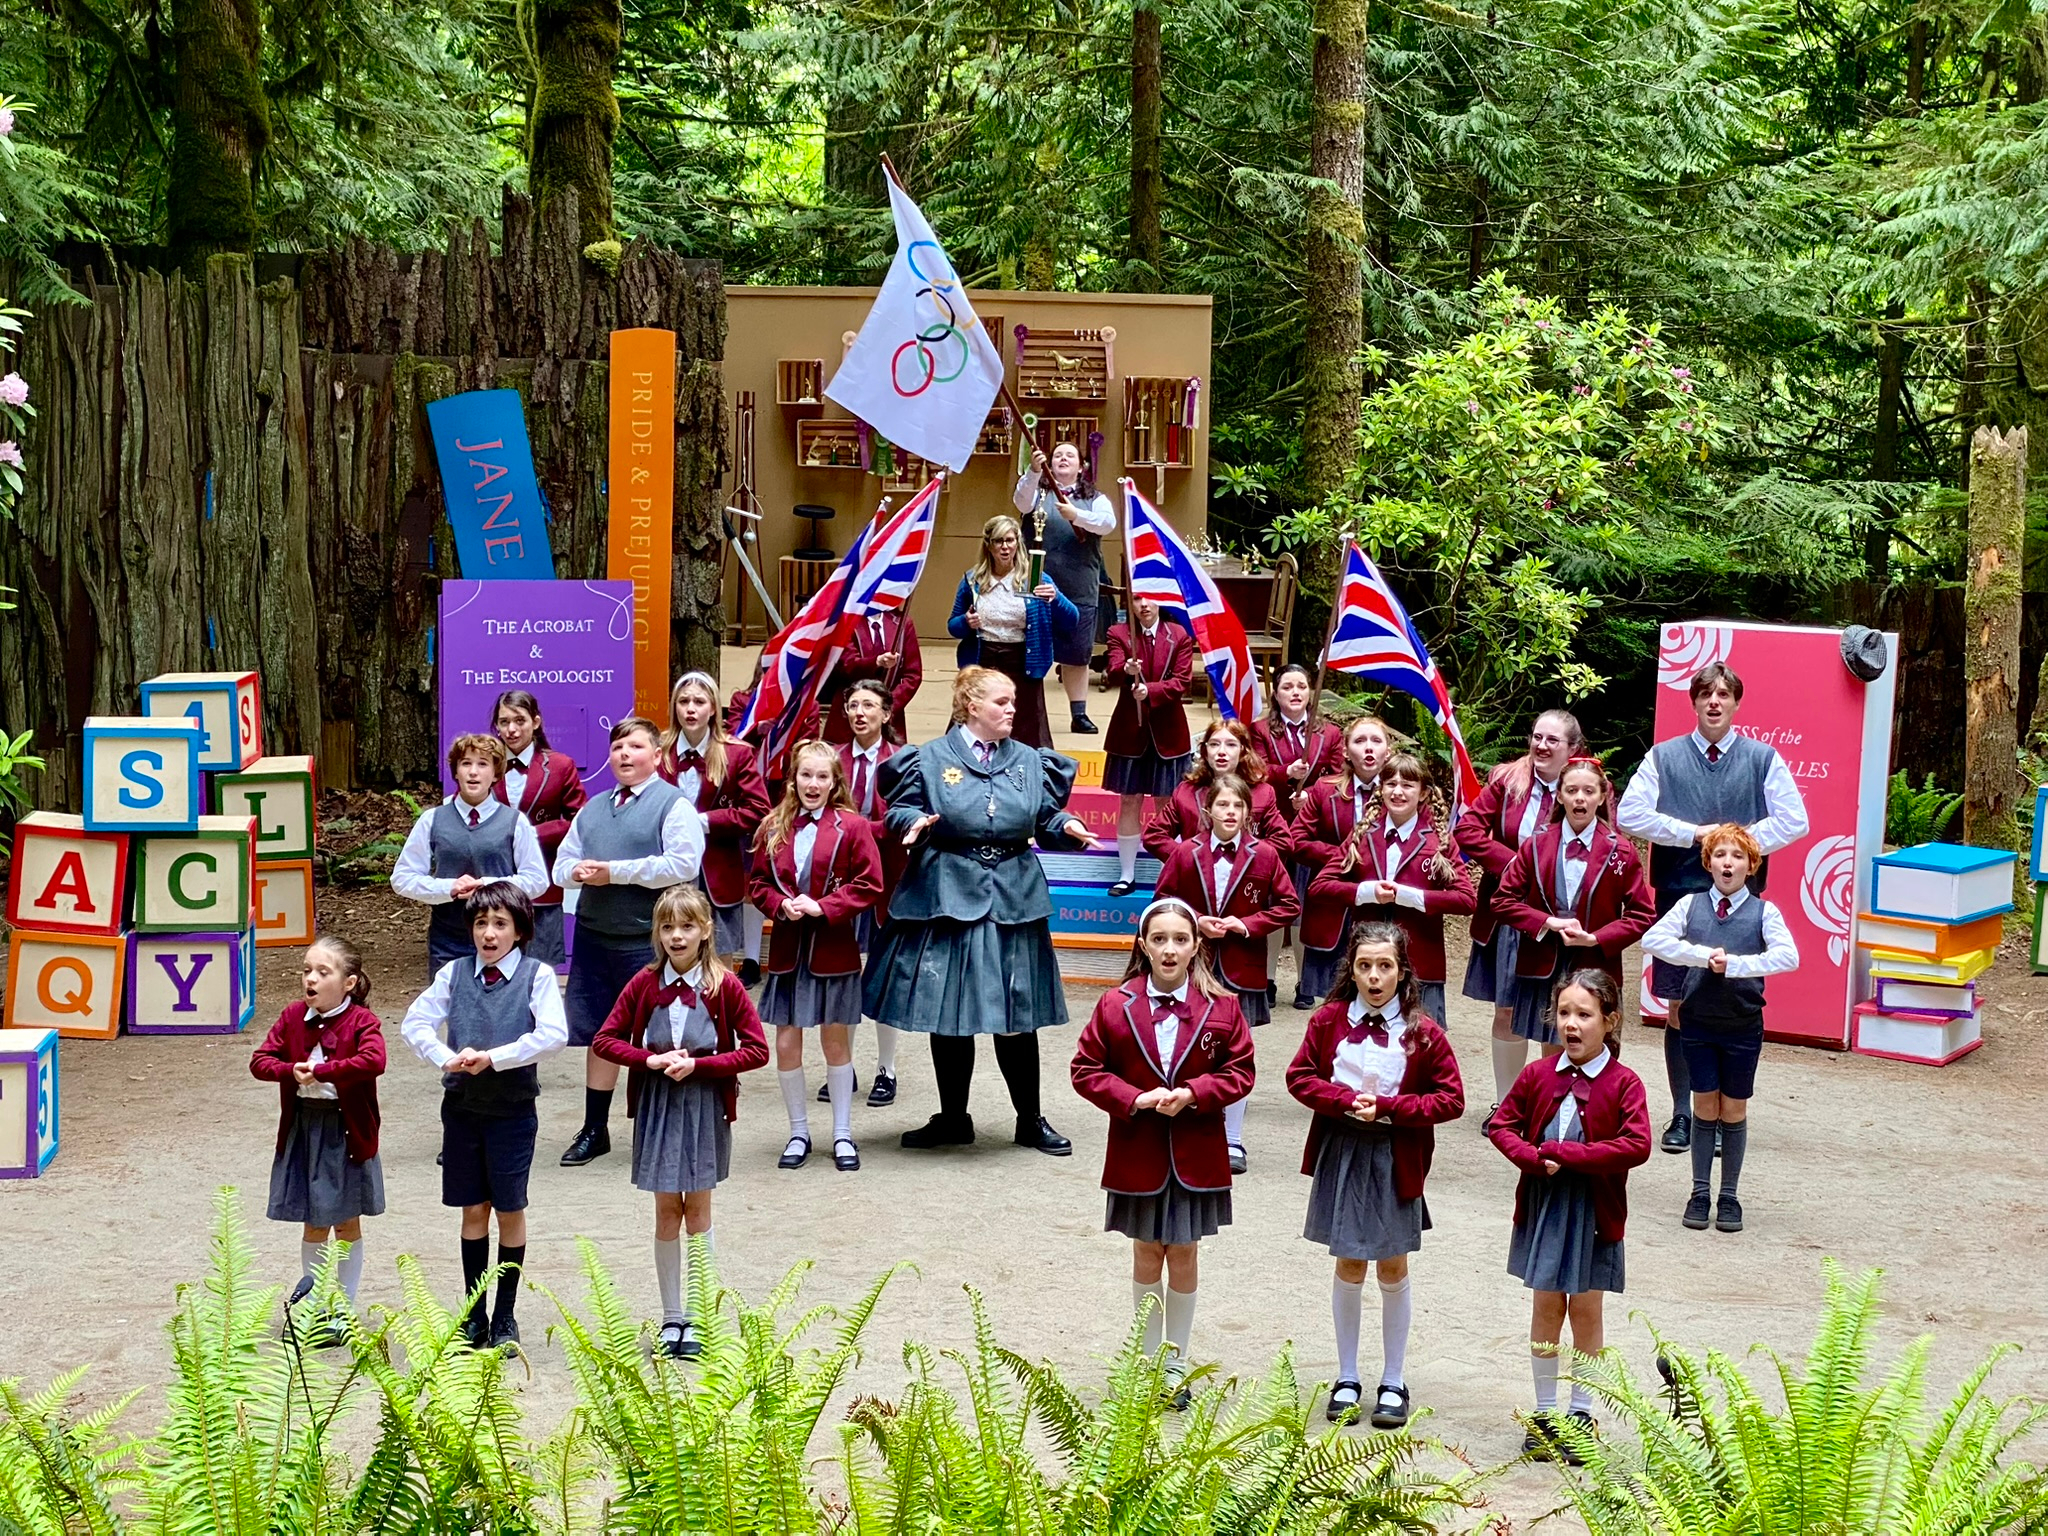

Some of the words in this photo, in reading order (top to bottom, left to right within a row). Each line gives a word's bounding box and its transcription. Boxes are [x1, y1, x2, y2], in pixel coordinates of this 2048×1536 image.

[630, 371, 653, 456] PRIDE
[629, 465, 650, 485] &
[455, 437, 525, 566] JANE
[624, 497, 652, 652] PREJUDICE
[482, 619, 518, 634] THE
[520, 618, 594, 634] ACROBAT
[529, 644, 543, 658] &
[461, 670, 495, 684] THE
[499, 668, 614, 684] ESCAPOLOGIST
[635, 690, 648, 699] NE
[183, 701, 211, 752] 4
[240, 695, 251, 746] S
[636, 702, 658, 711] TEN
[1761, 726, 1781, 746] of
[1779, 729, 1803, 745] the
[118, 750, 164, 809] S
[1786, 760, 1830, 779] LLES
[244, 791, 285, 841] L
[34, 851, 96, 913] A
[167, 852, 217, 910] C
[255, 879, 286, 928] L
[1059, 907, 1124, 924] ROMEO
[1127, 912, 1140, 925] &
[37, 957, 93, 1017] Q
[154, 953, 213, 1012] Y
[39, 1064, 48, 1139] 5
